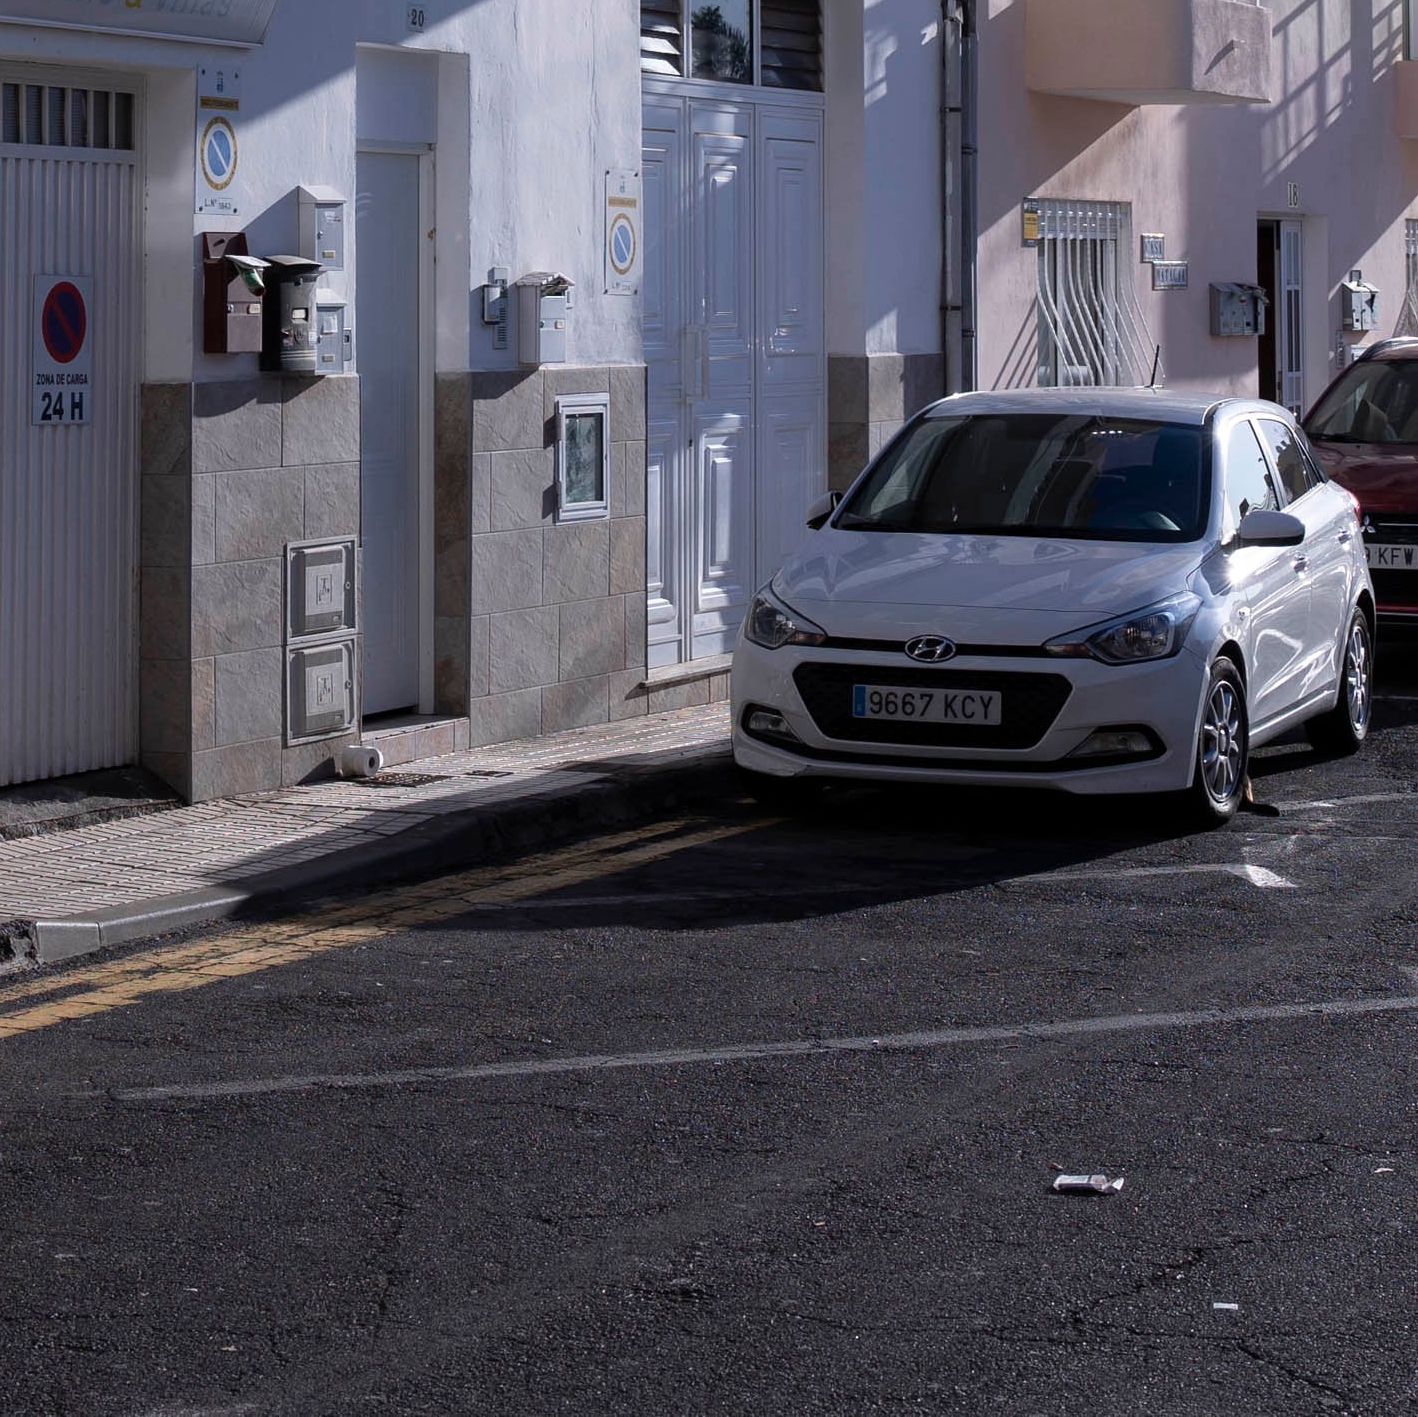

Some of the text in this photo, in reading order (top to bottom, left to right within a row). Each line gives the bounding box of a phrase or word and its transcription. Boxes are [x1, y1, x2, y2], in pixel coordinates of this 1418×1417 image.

[411, 8, 425, 28] 20
[1288, 183, 1298, 207] 18
[36, 373, 89, 385] ZONA DE CARGA
[40, 391, 84, 421] 24 H
[1378, 547, 1414, 566] KFW
[869, 690, 934, 718] 9667
[943, 693, 993, 720] KCY
